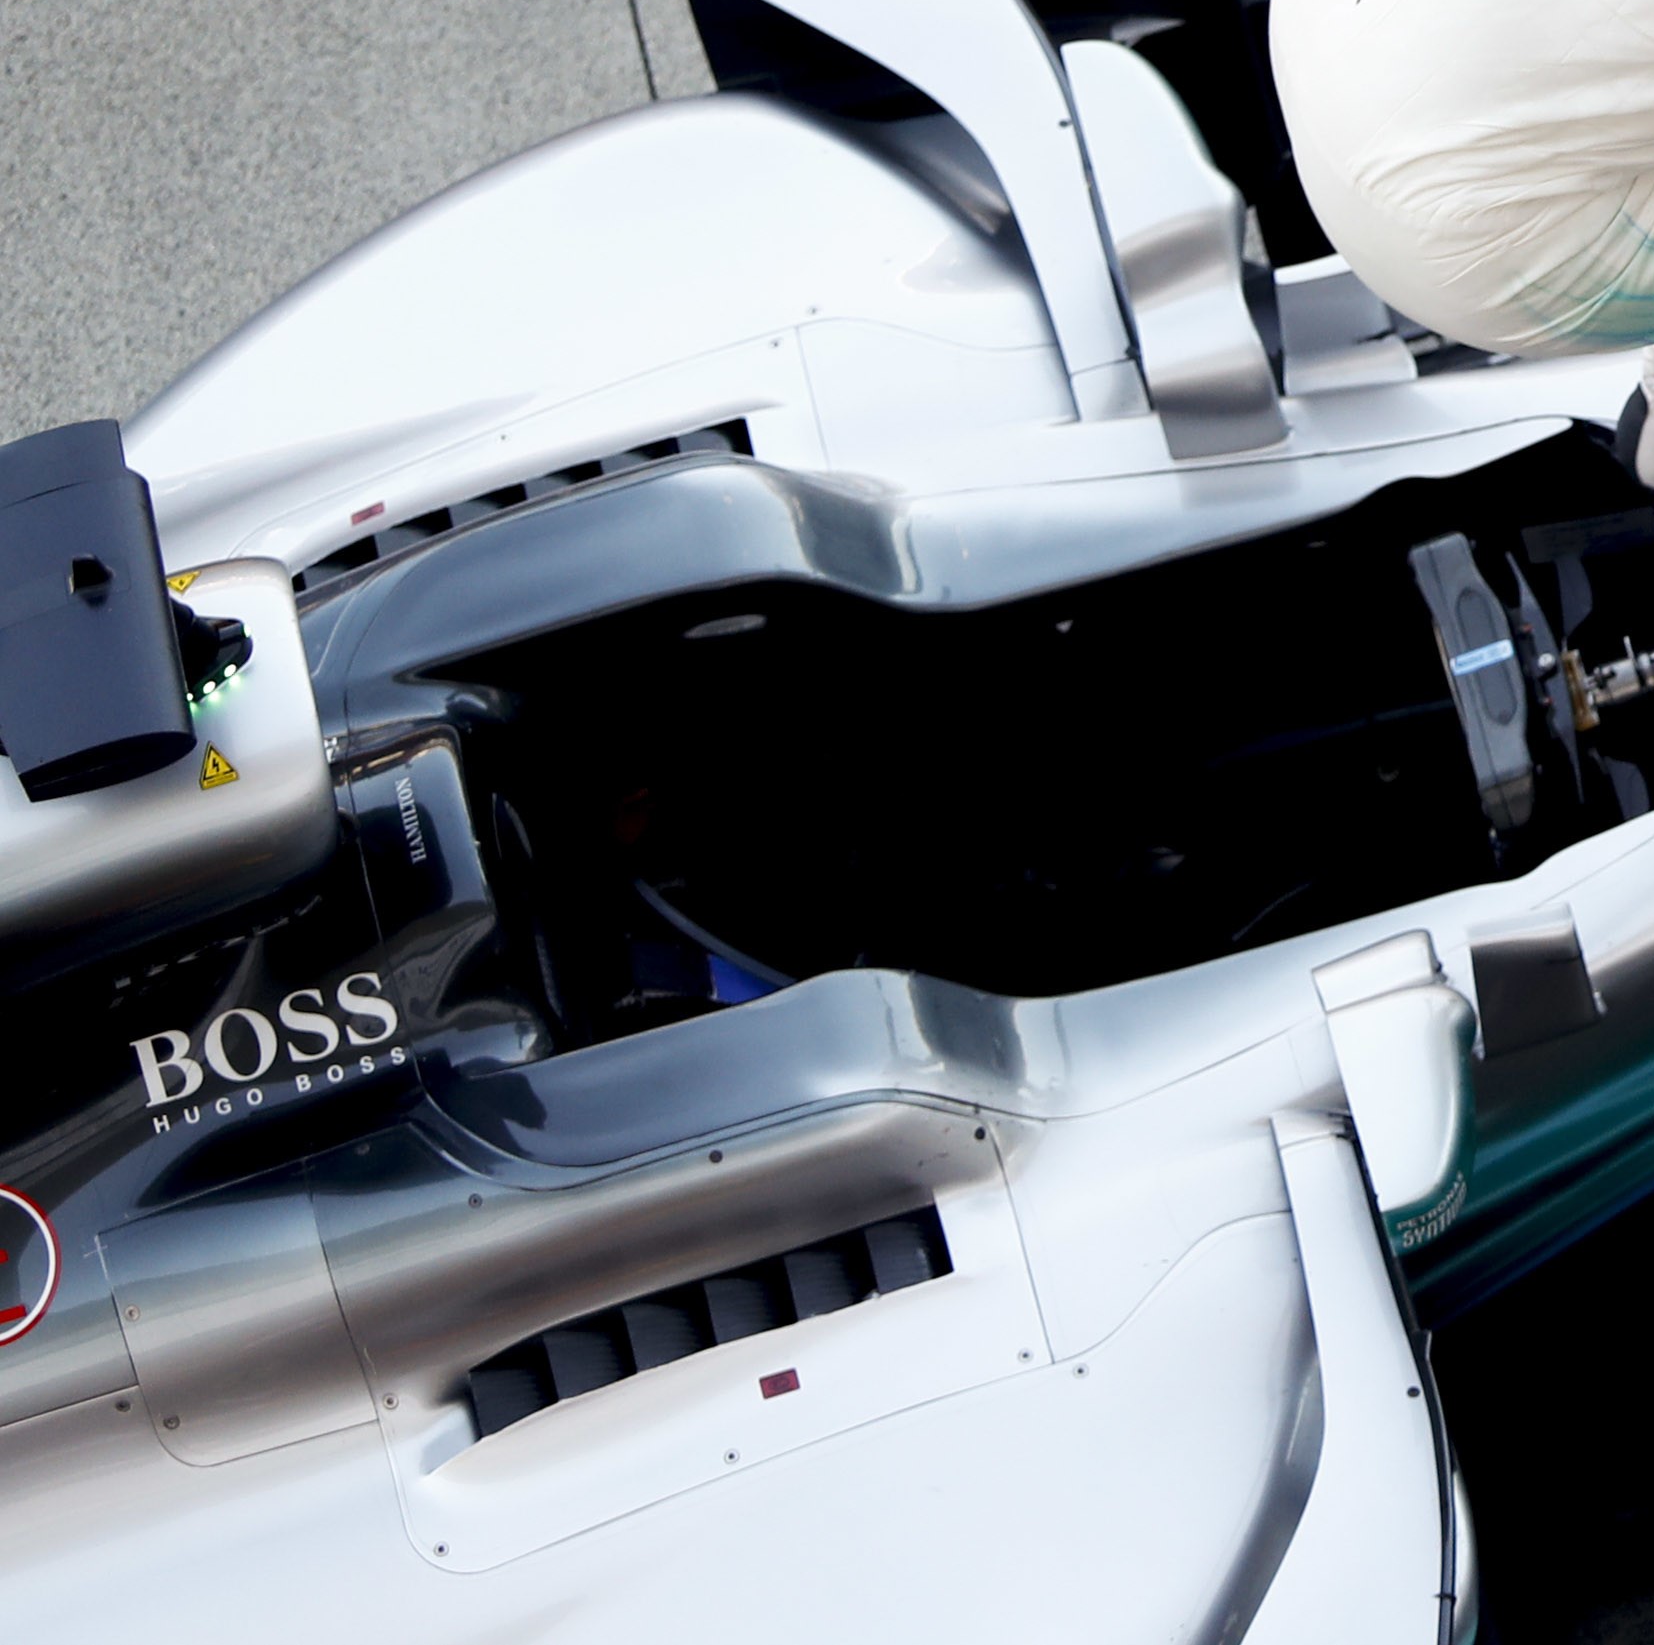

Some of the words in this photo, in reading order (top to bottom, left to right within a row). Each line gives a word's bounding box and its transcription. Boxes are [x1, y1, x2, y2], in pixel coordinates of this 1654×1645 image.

[394, 776, 427, 865] HAMILTON
[129, 972, 398, 1108] BOSS
[153, 1088, 263, 1134] HUGO
[295, 1046, 406, 1093] BOSS
